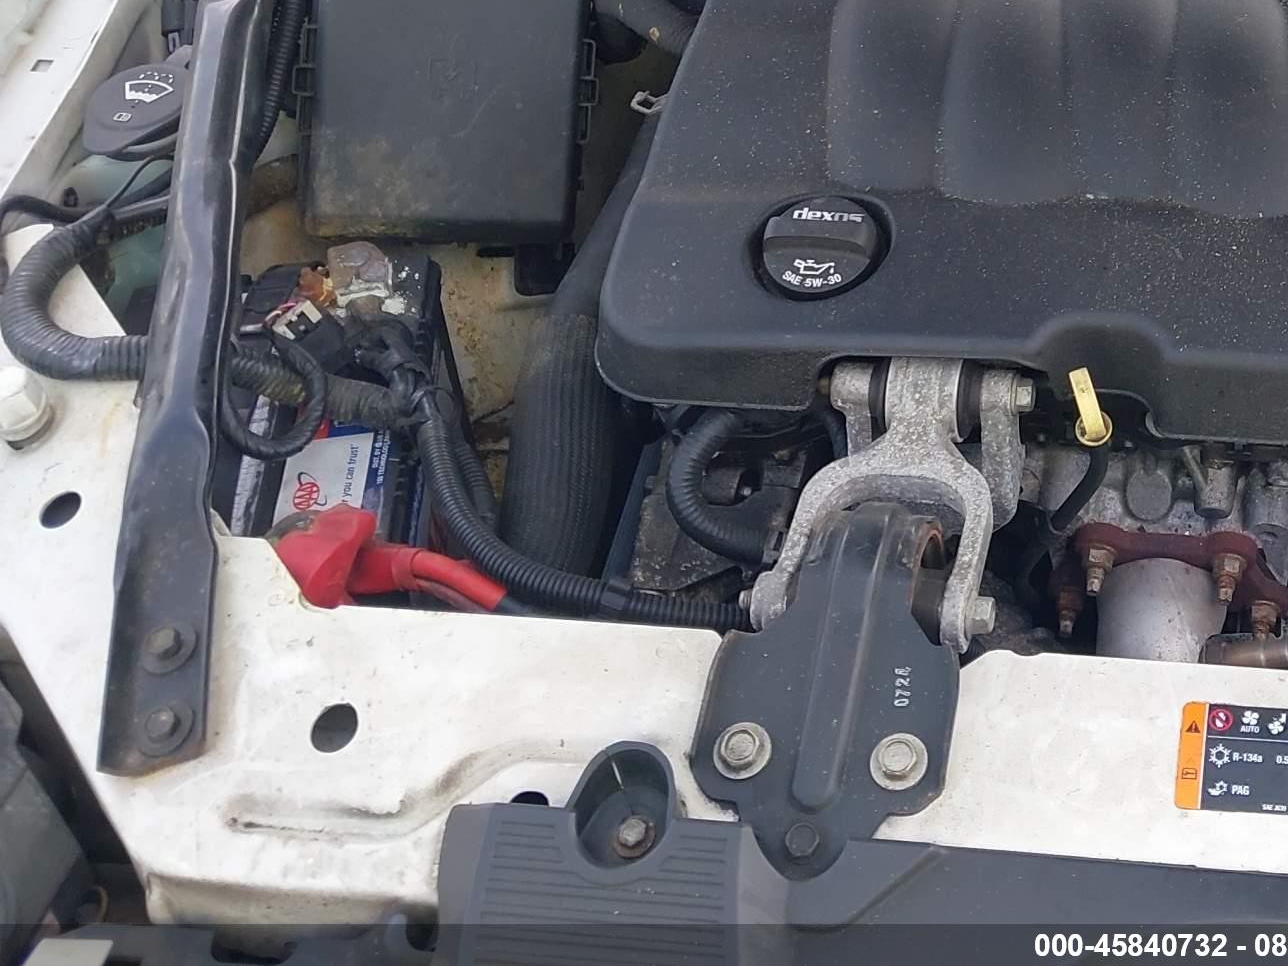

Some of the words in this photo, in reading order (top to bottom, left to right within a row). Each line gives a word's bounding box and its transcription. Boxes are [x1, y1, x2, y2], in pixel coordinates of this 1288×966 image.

[782, 270, 803, 286] SAE
[804, 273, 842, 288] 5W-30
[347, 466, 355, 480] can
[342, 482, 353, 498] you
[1240, 725, 1260, 733] AUTO
[1232, 752, 1263, 763] R-134a
[1231, 784, 1250, 796] PAG
